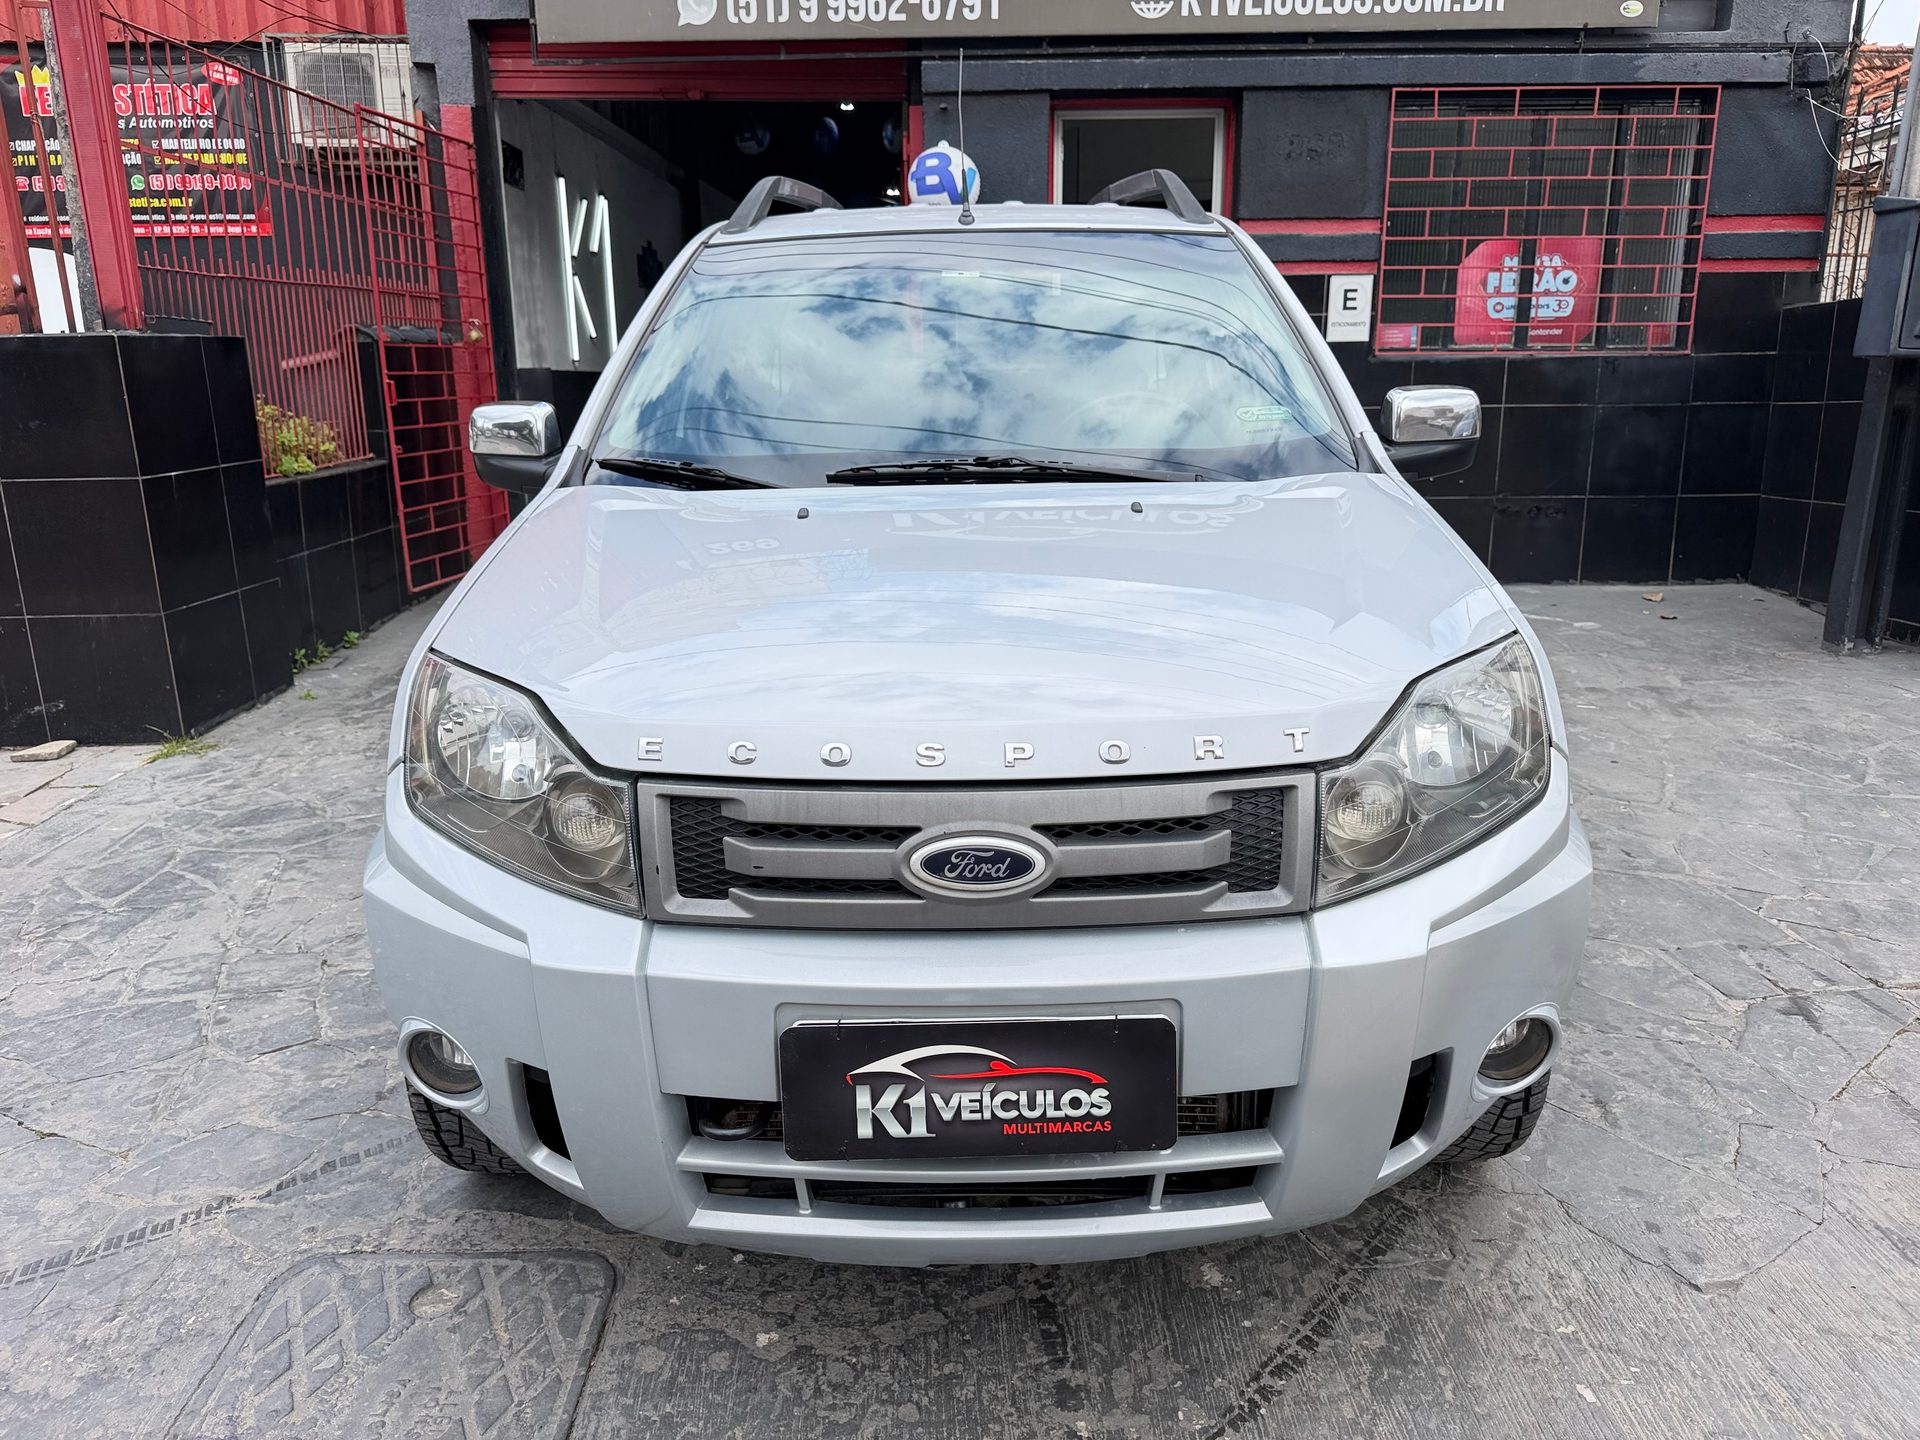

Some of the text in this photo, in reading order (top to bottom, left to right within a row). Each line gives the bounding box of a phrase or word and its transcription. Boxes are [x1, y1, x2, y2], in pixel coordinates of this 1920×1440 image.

[726, 0, 790, 24] (51)
[799, 0, 819, 23] 9
[15, 138, 60, 152] CHAPÇÃO
[17, 154, 63, 166] PINRA
[32, 175, 56, 192] (5)
[149, 174, 174, 191] (5)
[1503, 254, 1563, 271] MGA
[1486, 268, 1578, 293] FERÃO
[1342, 289, 1358, 311] E
[943, 847, 1012, 882] Ford
[856, 1082, 1112, 1139] K1 VEÍCULOS
[1003, 1121, 1112, 1135] MULTIMARCAS
